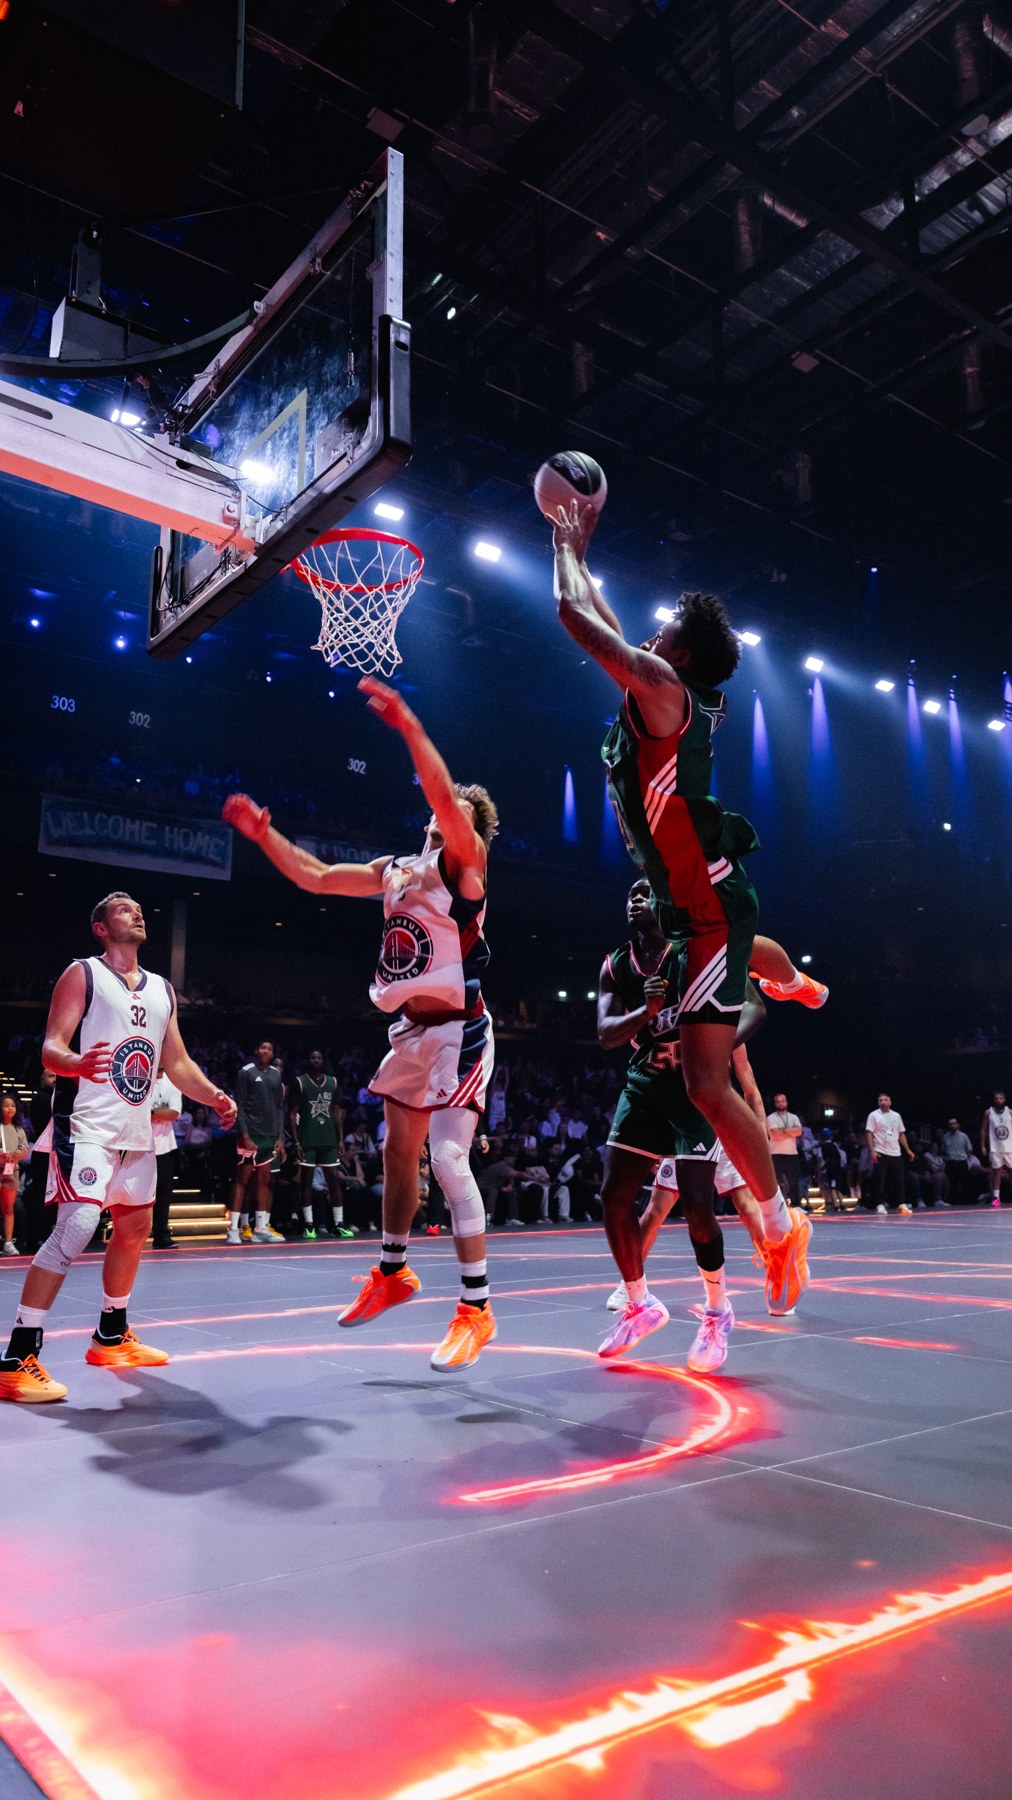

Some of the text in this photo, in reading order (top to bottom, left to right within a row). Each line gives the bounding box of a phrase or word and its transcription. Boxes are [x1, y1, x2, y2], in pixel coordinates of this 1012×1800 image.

[50, 695, 76, 713] 303
[128, 711, 151, 729] 302
[347, 757, 367, 775] 302
[46, 810, 226, 861] WELCOME HOME
[382, 967, 419, 982] UNITED
[130, 1004, 147, 1029] 32
[119, 1042, 155, 1061] ISTANBUL
[122, 1086, 147, 1102] UNITED
